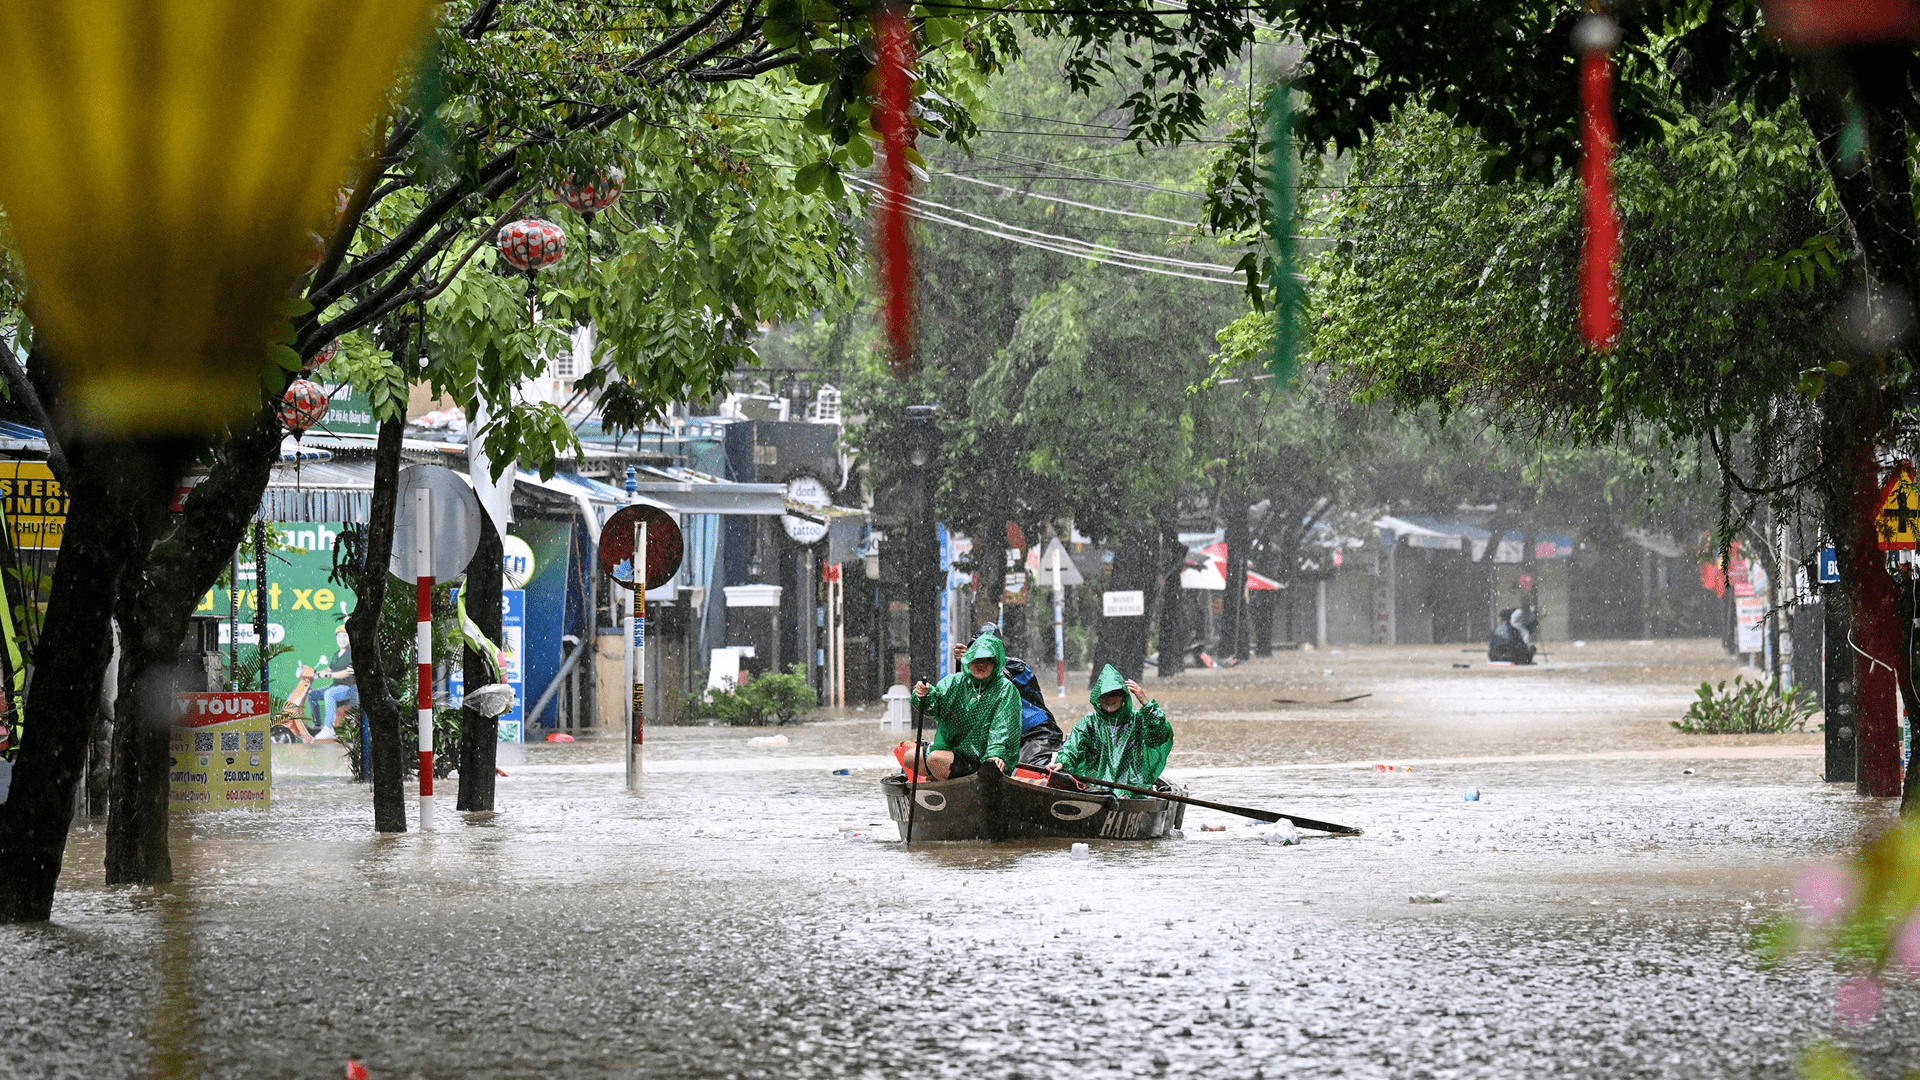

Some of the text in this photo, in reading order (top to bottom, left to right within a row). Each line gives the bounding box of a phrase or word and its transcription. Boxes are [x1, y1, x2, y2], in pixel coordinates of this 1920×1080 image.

[0, 480, 69, 497] STER
[503, 555, 526, 573] TM
[291, 588, 335, 610] xe
[177, 699, 254, 714] Y TOUR
[224, 771, 250, 782] 250.000
[252, 771, 264, 782] vnd
[1099, 810, 1125, 837] HA
